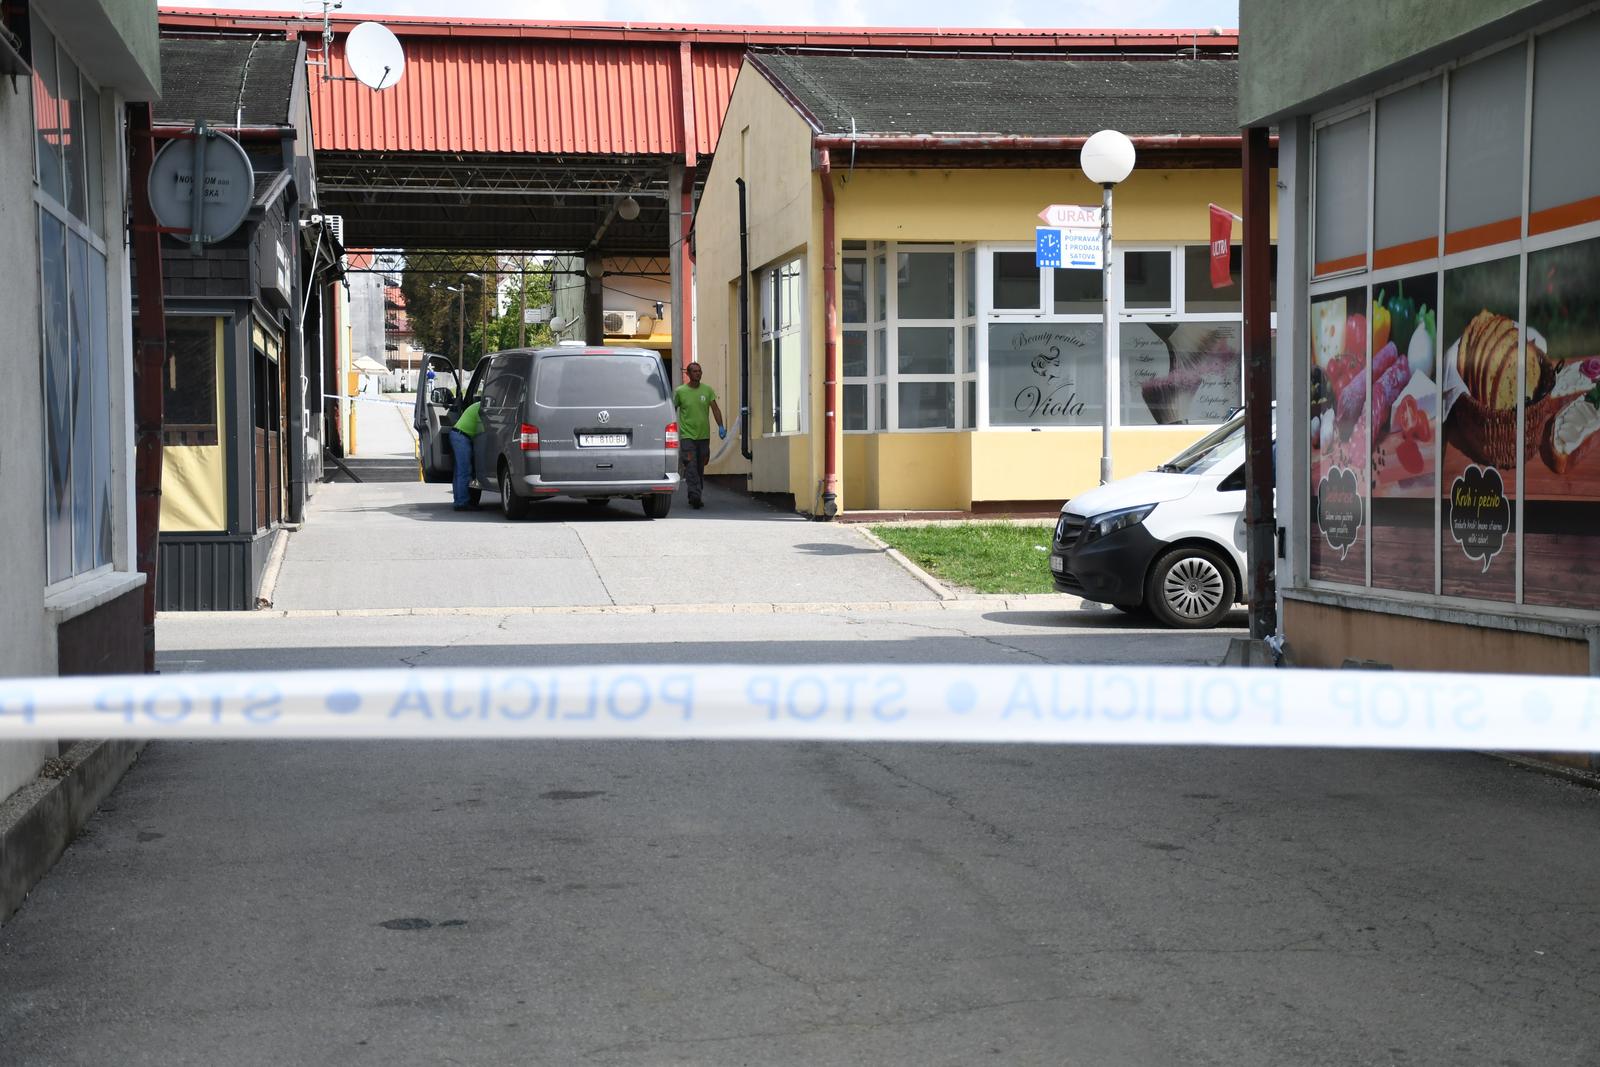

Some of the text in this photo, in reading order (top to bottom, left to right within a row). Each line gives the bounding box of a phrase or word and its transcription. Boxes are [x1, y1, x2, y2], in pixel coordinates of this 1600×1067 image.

[1057, 209, 1096, 222] URAR
[1012, 331, 1053, 350] Beauty
[1014, 383, 1085, 418] Viola
[585, 435, 594, 444] KT
[1455, 487, 1500, 518] Kruh i pecivo
